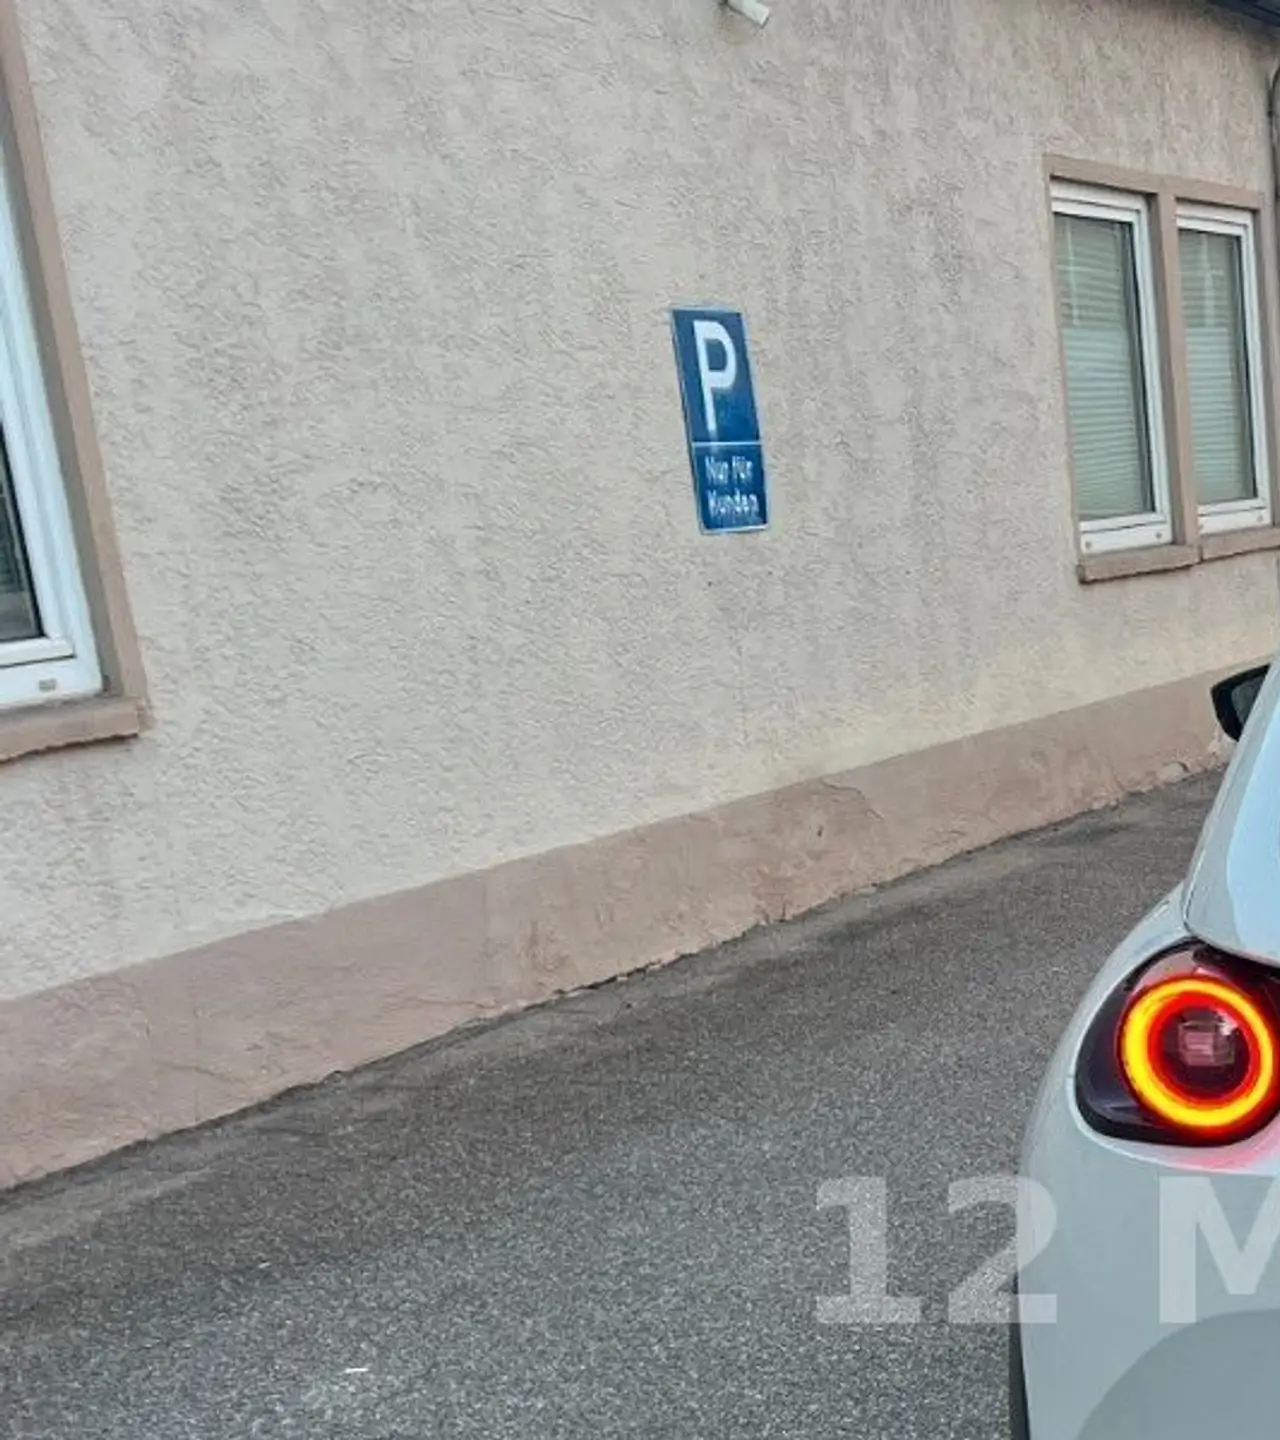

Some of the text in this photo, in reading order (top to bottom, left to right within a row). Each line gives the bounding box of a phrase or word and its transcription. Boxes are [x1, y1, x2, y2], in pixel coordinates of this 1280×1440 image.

[693, 320, 736, 439] P
[704, 456, 729, 484] Nur
[706, 489, 760, 518] Kunden
